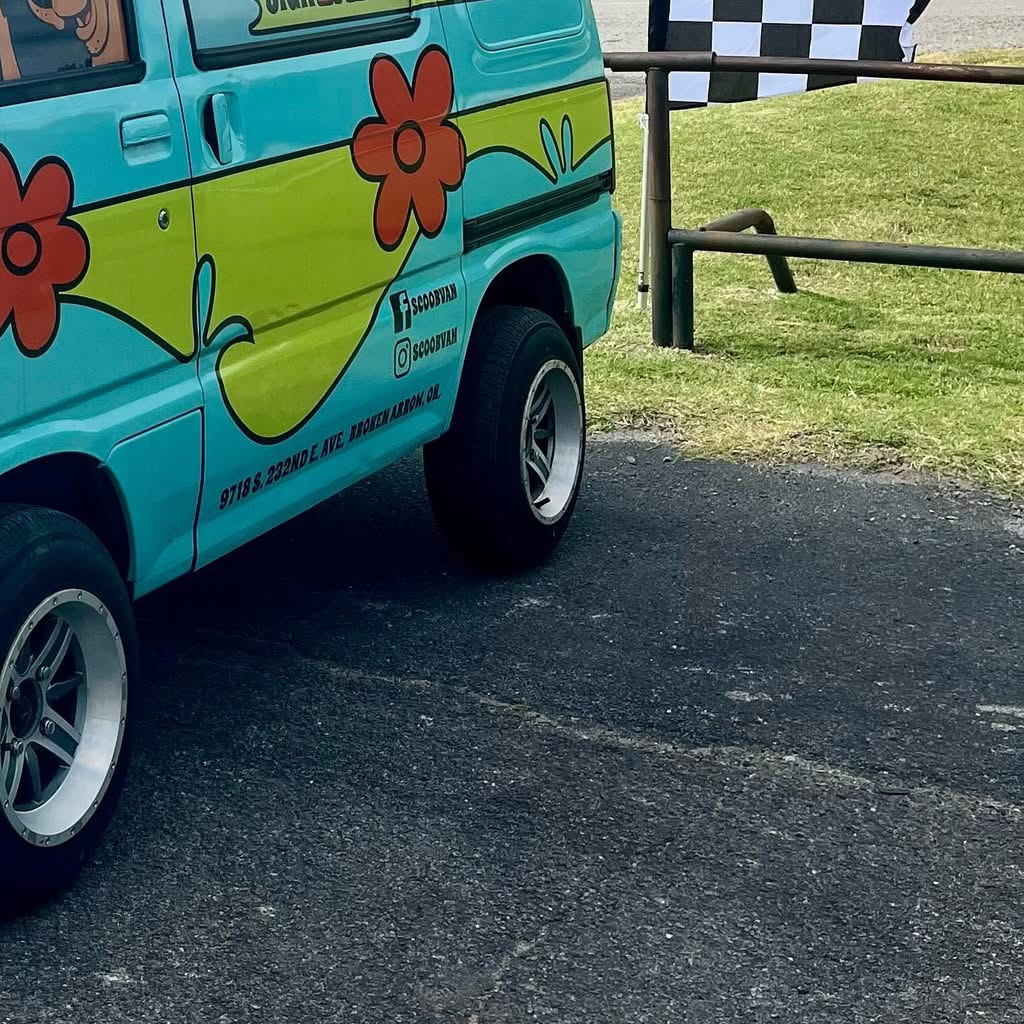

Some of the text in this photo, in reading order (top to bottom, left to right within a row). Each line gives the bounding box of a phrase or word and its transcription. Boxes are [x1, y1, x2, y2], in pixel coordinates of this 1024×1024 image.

[411, 282, 458, 316] SCOOBVAN
[412, 327, 458, 362] SCOOBVAN
[219, 477, 252, 511] 9718
[265, 449, 309, 487] 232ND
